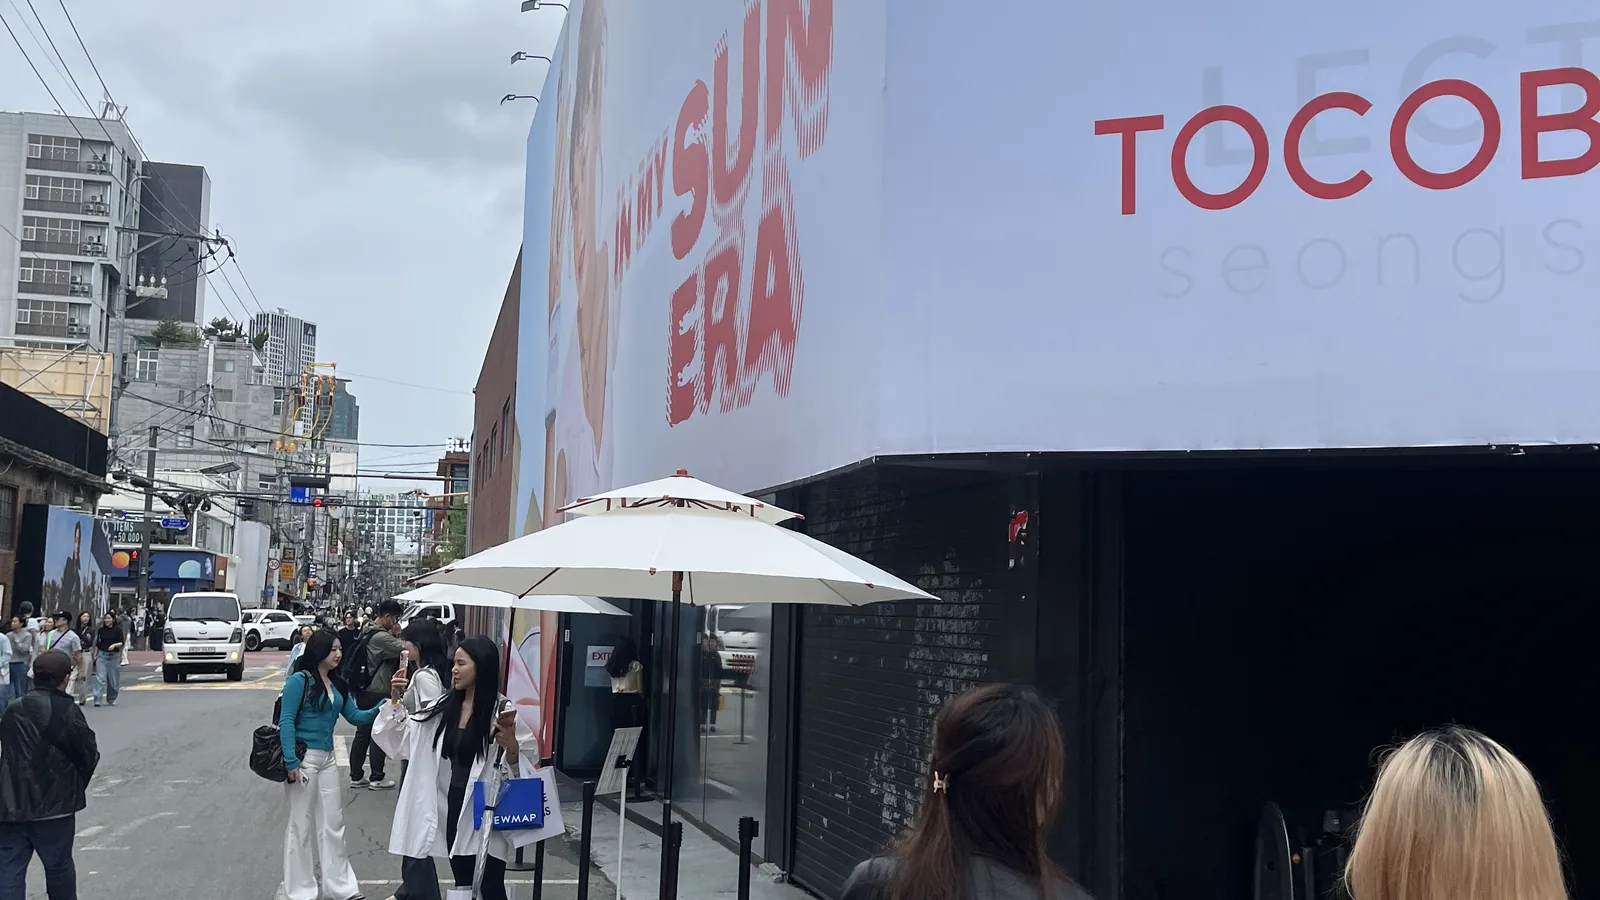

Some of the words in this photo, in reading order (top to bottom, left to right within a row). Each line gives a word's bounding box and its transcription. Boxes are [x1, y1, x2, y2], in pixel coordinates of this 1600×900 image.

[614, 190, 632, 287] IN
[636, 132, 668, 252] MY
[671, 0, 833, 260] SUN
[1094, 67, 1600, 215] TOCOB
[1158, 217, 1586, 305] seongs
[667, 205, 804, 427] ERA
[113, 521, 134, 532] ITEMS
[592, 651, 613, 661] EXIT
[481, 813, 537, 825] EWMAP
